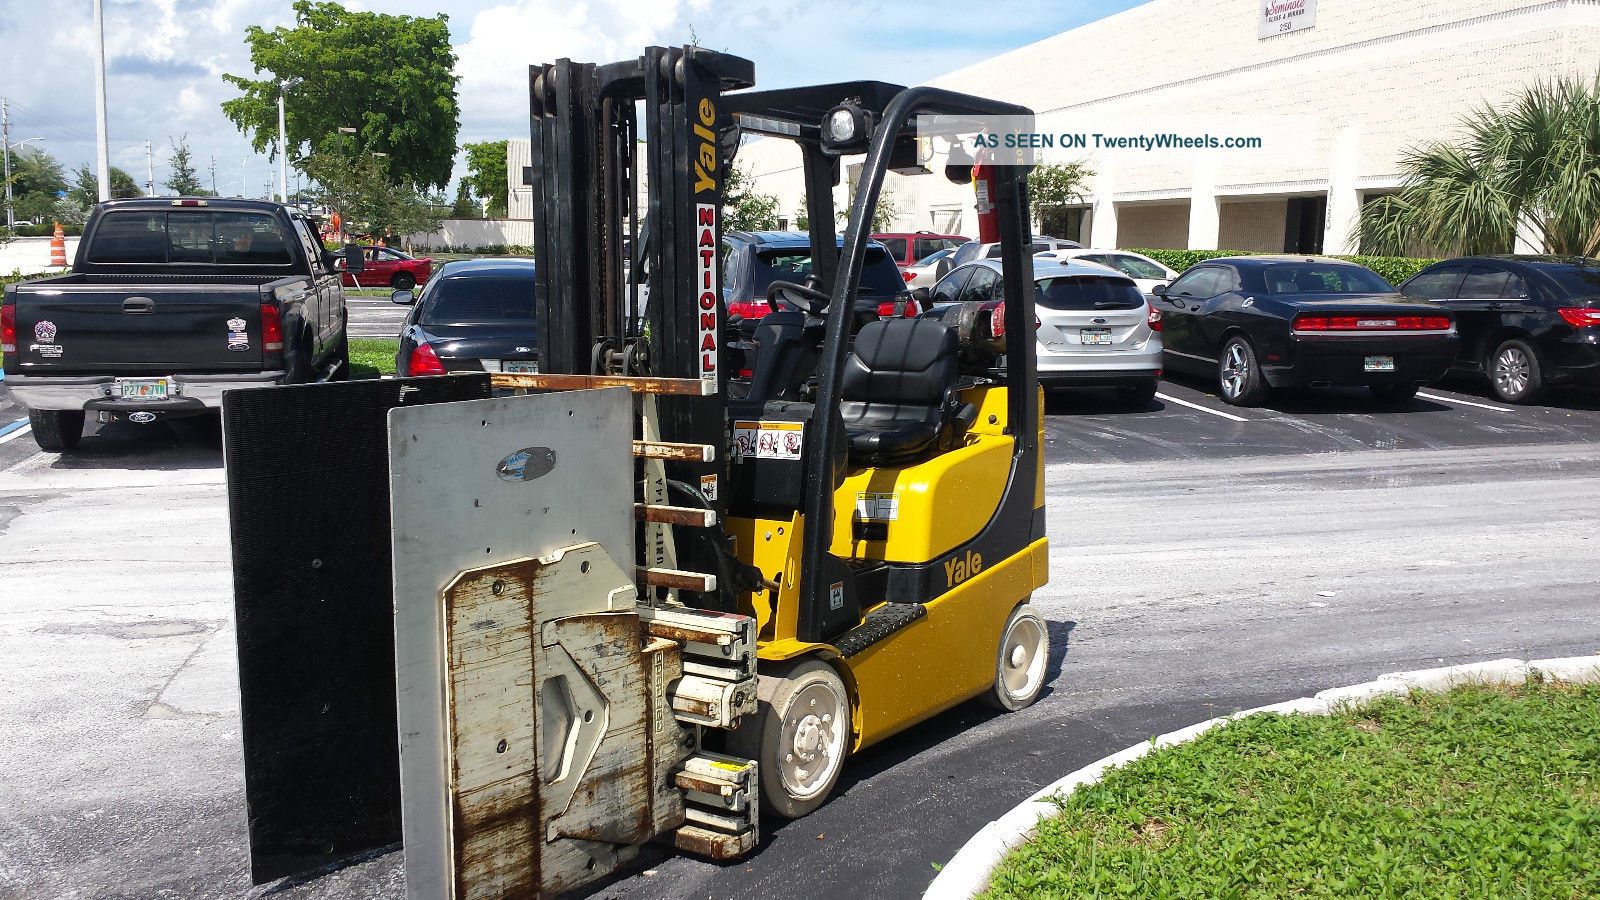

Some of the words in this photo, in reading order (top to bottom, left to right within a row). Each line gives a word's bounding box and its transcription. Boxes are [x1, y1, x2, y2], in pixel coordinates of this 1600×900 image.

[695, 97, 716, 194] Yale
[699, 207, 717, 373] NATIONAL
[944, 549, 982, 588] Yale
